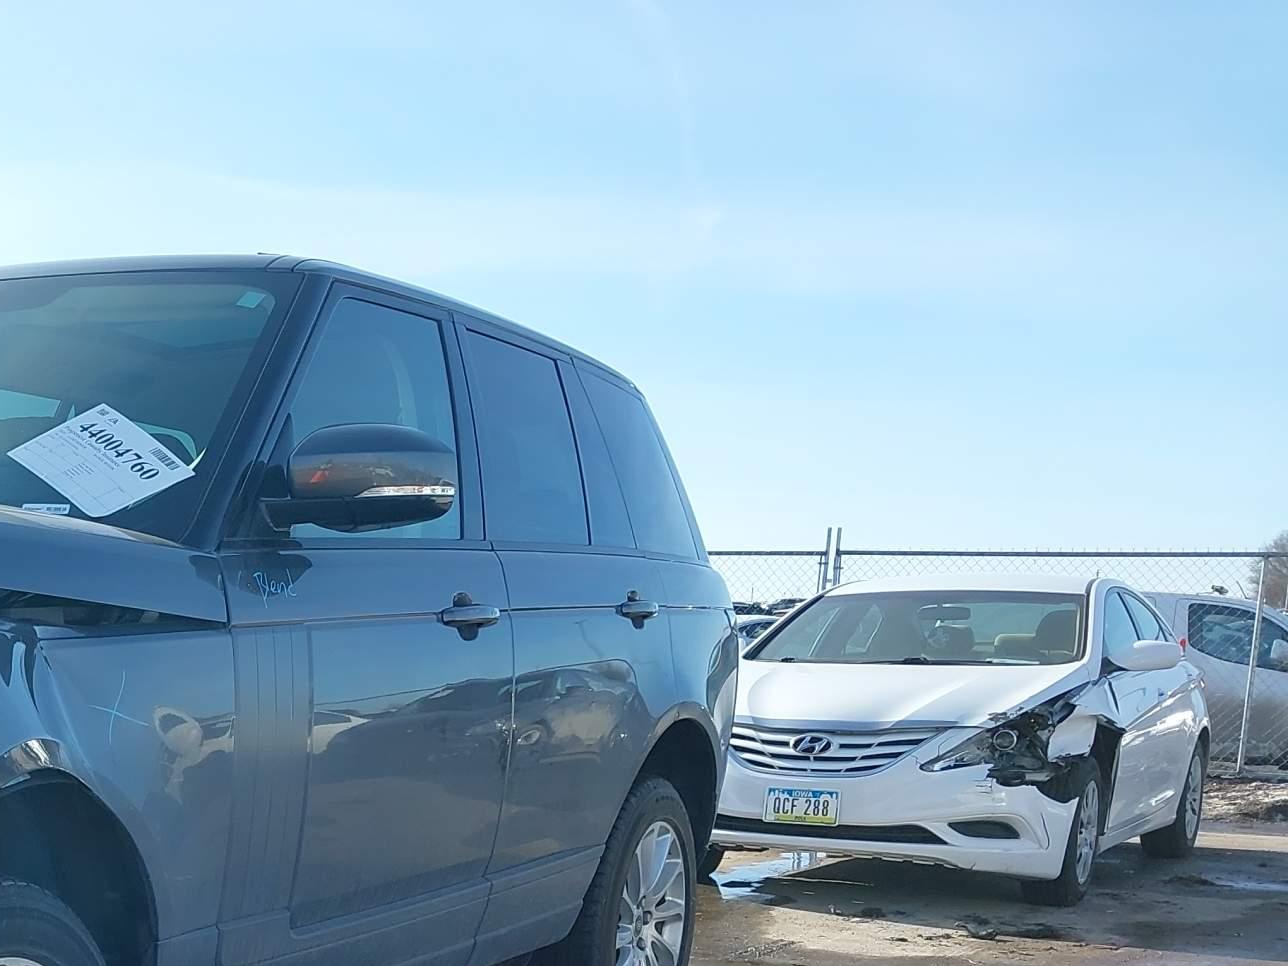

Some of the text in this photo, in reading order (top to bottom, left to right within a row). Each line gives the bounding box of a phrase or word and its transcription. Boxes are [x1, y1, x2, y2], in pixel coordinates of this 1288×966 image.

[80, 422, 160, 480] 44004760
[792, 790, 813, 798] IOWA
[773, 797, 829, 816] QCF 288
